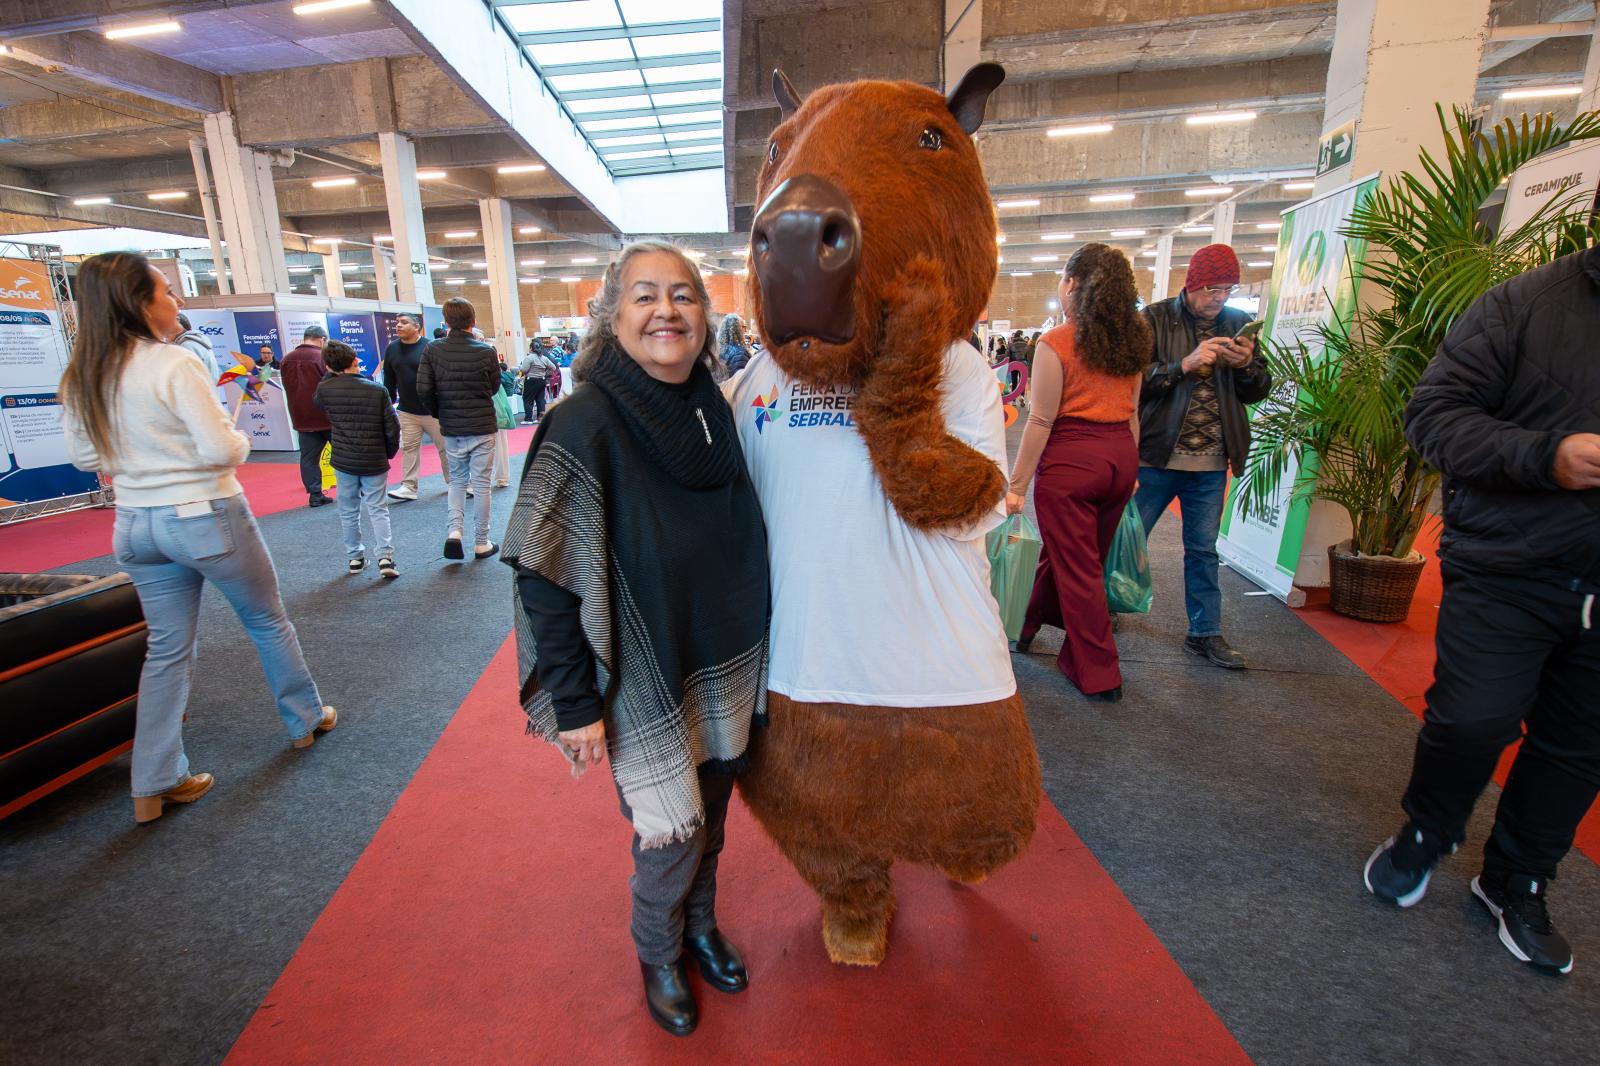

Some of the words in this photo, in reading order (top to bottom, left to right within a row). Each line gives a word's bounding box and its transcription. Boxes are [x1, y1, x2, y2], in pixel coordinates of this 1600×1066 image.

[1524, 172, 1583, 197] CERAMIQUE
[340, 320, 360, 328] Senac
[198, 326, 225, 336] Sesc
[341, 327, 364, 335] Paraná
[791, 384, 836, 396] FEIRA
[17, 397, 37, 405] 13/09
